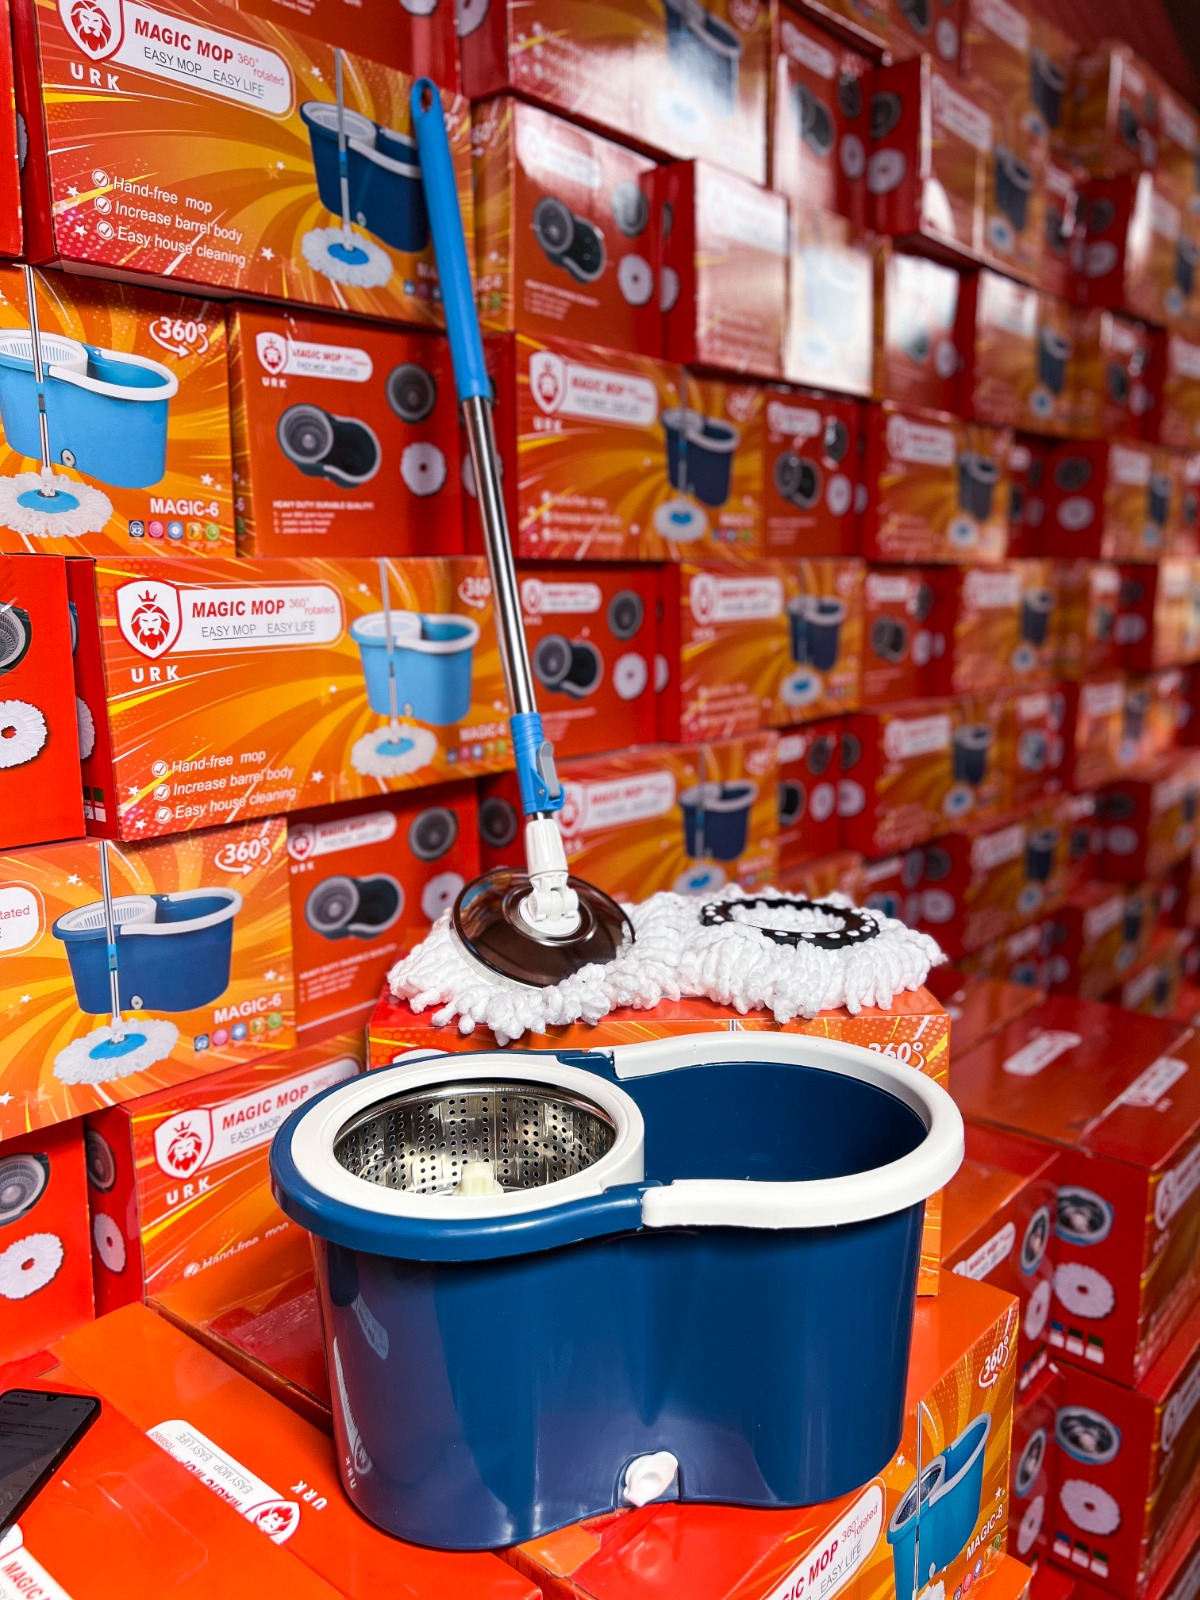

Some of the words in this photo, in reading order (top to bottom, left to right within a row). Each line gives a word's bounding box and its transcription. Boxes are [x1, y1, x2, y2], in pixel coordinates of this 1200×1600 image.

[134, 18, 192, 51] MAGIC
[197, 39, 234, 64] MOP
[253, 68, 284, 86] rotated
[70, 62, 120, 91] URK
[144, 47, 174, 65] EASY
[177, 58, 201, 74] MOP
[213, 70, 241, 88] EASY
[243, 79, 264, 96] LIFE
[113, 176, 178, 204] Hand-free
[185, 197, 212, 214] mop
[115, 201, 171, 226] Increase
[175, 215, 210, 234] barrel
[213, 224, 243, 245] body
[117, 226, 150, 248] Easy
[154, 235, 192, 254] house
[196, 245, 246, 268] cleaning
[159, 317, 207, 343] 360°
[262, 376, 287, 389] URK
[150, 498, 219, 517] MAGIC-6
[192, 600, 246, 618] MAGIC
[251, 600, 285, 616] MOP
[304, 604, 336, 616] rotated
[201, 626, 230, 638] EASY
[233, 624, 257, 636] MOP
[267, 622, 294, 634] EASY
[296, 620, 316, 632] LIFE
[130, 665, 180, 683] URK
[171, 754, 234, 774] Hand-free
[240, 750, 266, 764] mop
[173, 778, 226, 796] Increase
[230, 771, 263, 787] barrel
[267, 765, 295, 780] body
[175, 804, 206, 819] Easy
[209, 797, 246, 813] house
[249, 787, 297, 805] cleaning
[224, 838, 270, 864] 360°
[0, 905, 30, 920] tated
[213, 992, 282, 1024] MAGIC-6
[222, 1099, 272, 1130] MAGIC
[276, 1085, 309, 1108] MOP
[230, 1126, 257, 1144] EASY
[259, 1115, 281, 1131] MOP
[166, 1176, 211, 1205] URK
[175, 1432, 194, 1448] LIFE
[191, 1444, 212, 1462] EASY
[213, 1463, 231, 1482] MOP
[230, 1477, 253, 1495] EASY
[290, 1480, 328, 1511] URK
[808, 1540, 839, 1586] MOP
[854, 1502, 878, 1538] rotated
[2, 1561, 43, 1599] MAGIC
[820, 1561, 844, 1594] EASY
[845, 1539, 862, 1567] LIFE
